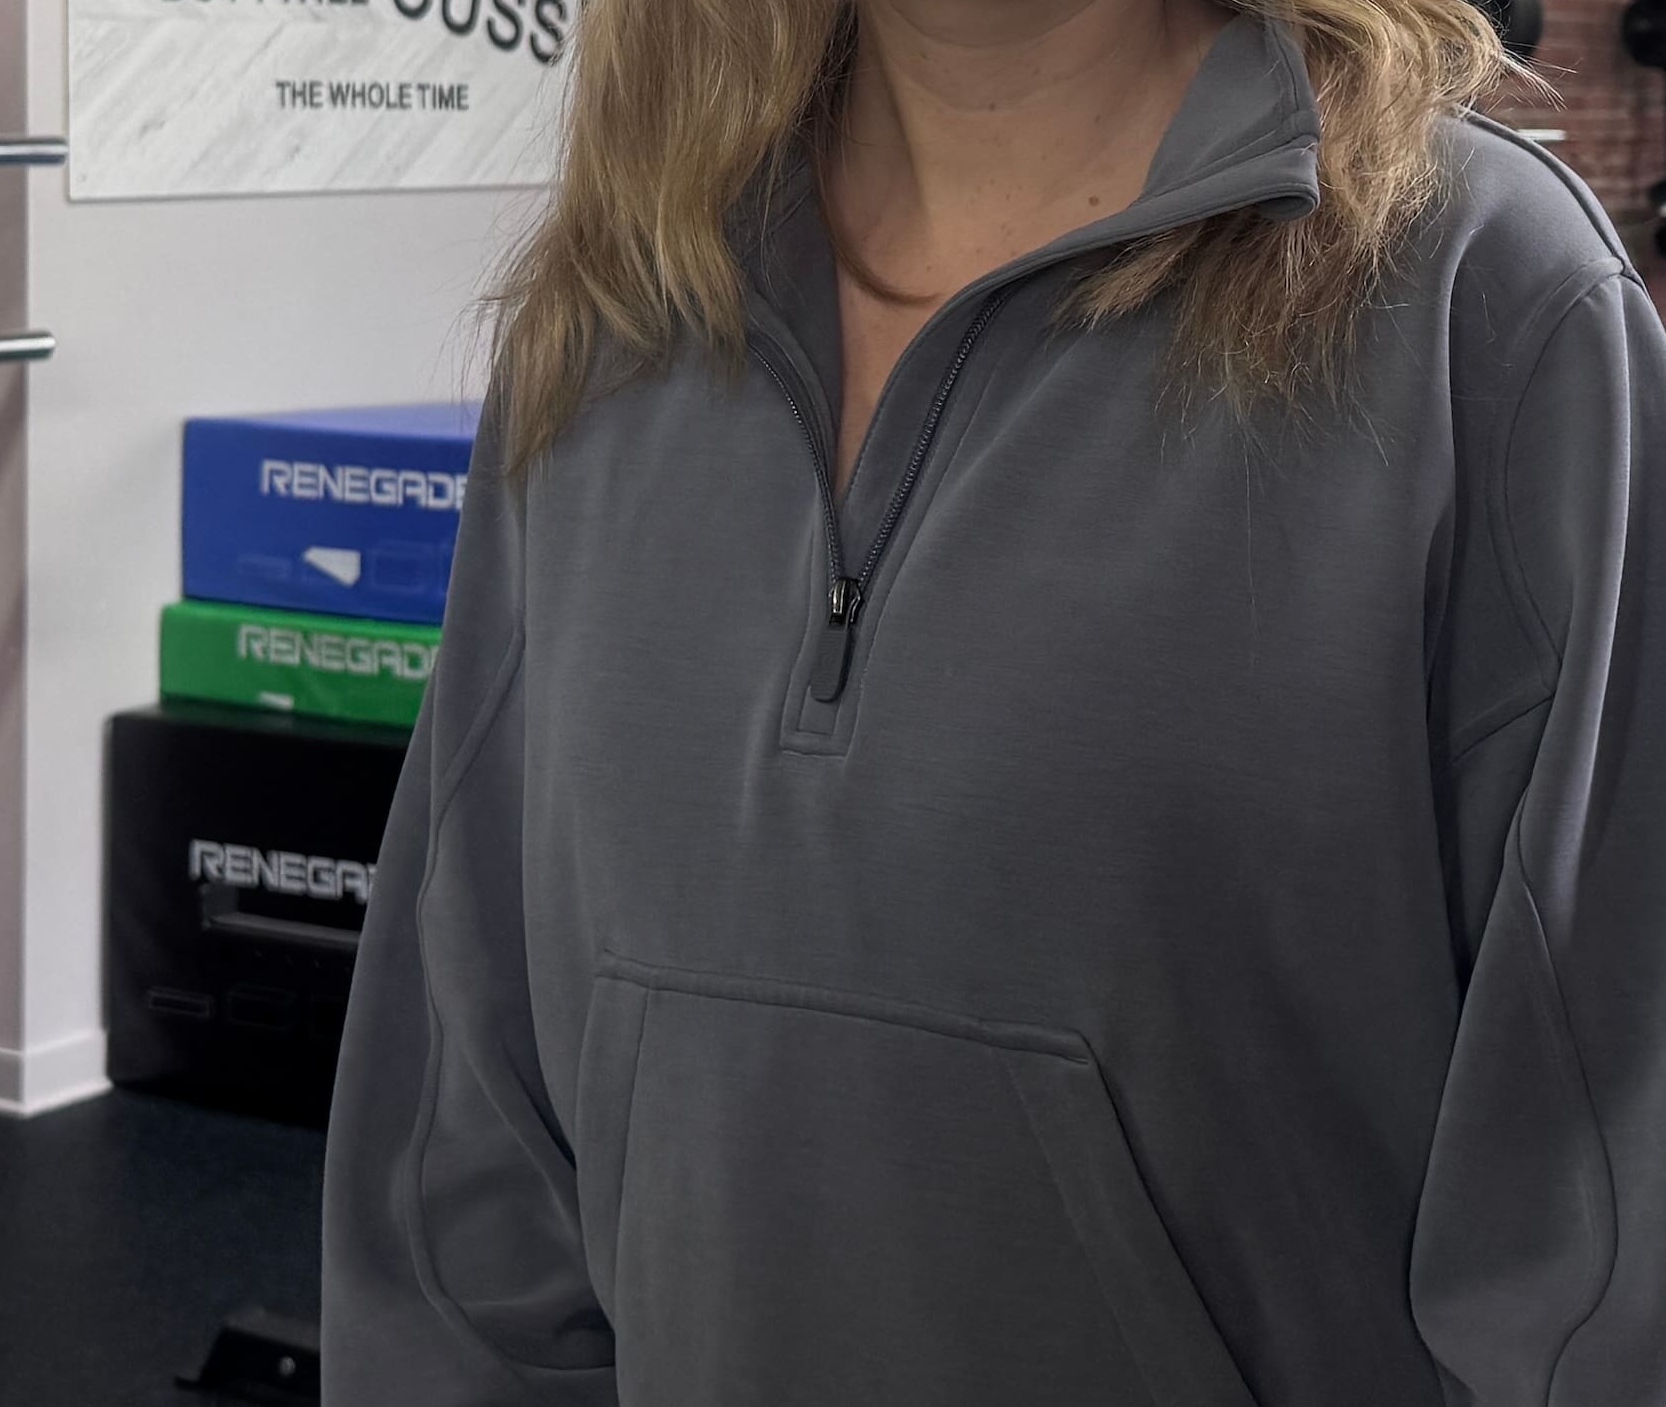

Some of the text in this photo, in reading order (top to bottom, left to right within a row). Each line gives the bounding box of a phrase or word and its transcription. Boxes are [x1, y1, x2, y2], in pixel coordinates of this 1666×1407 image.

[275, 80, 469, 111] THE WHOLE TIME
[237, 624, 440, 681] RENEGAD
[189, 839, 378, 906] RENEGA
